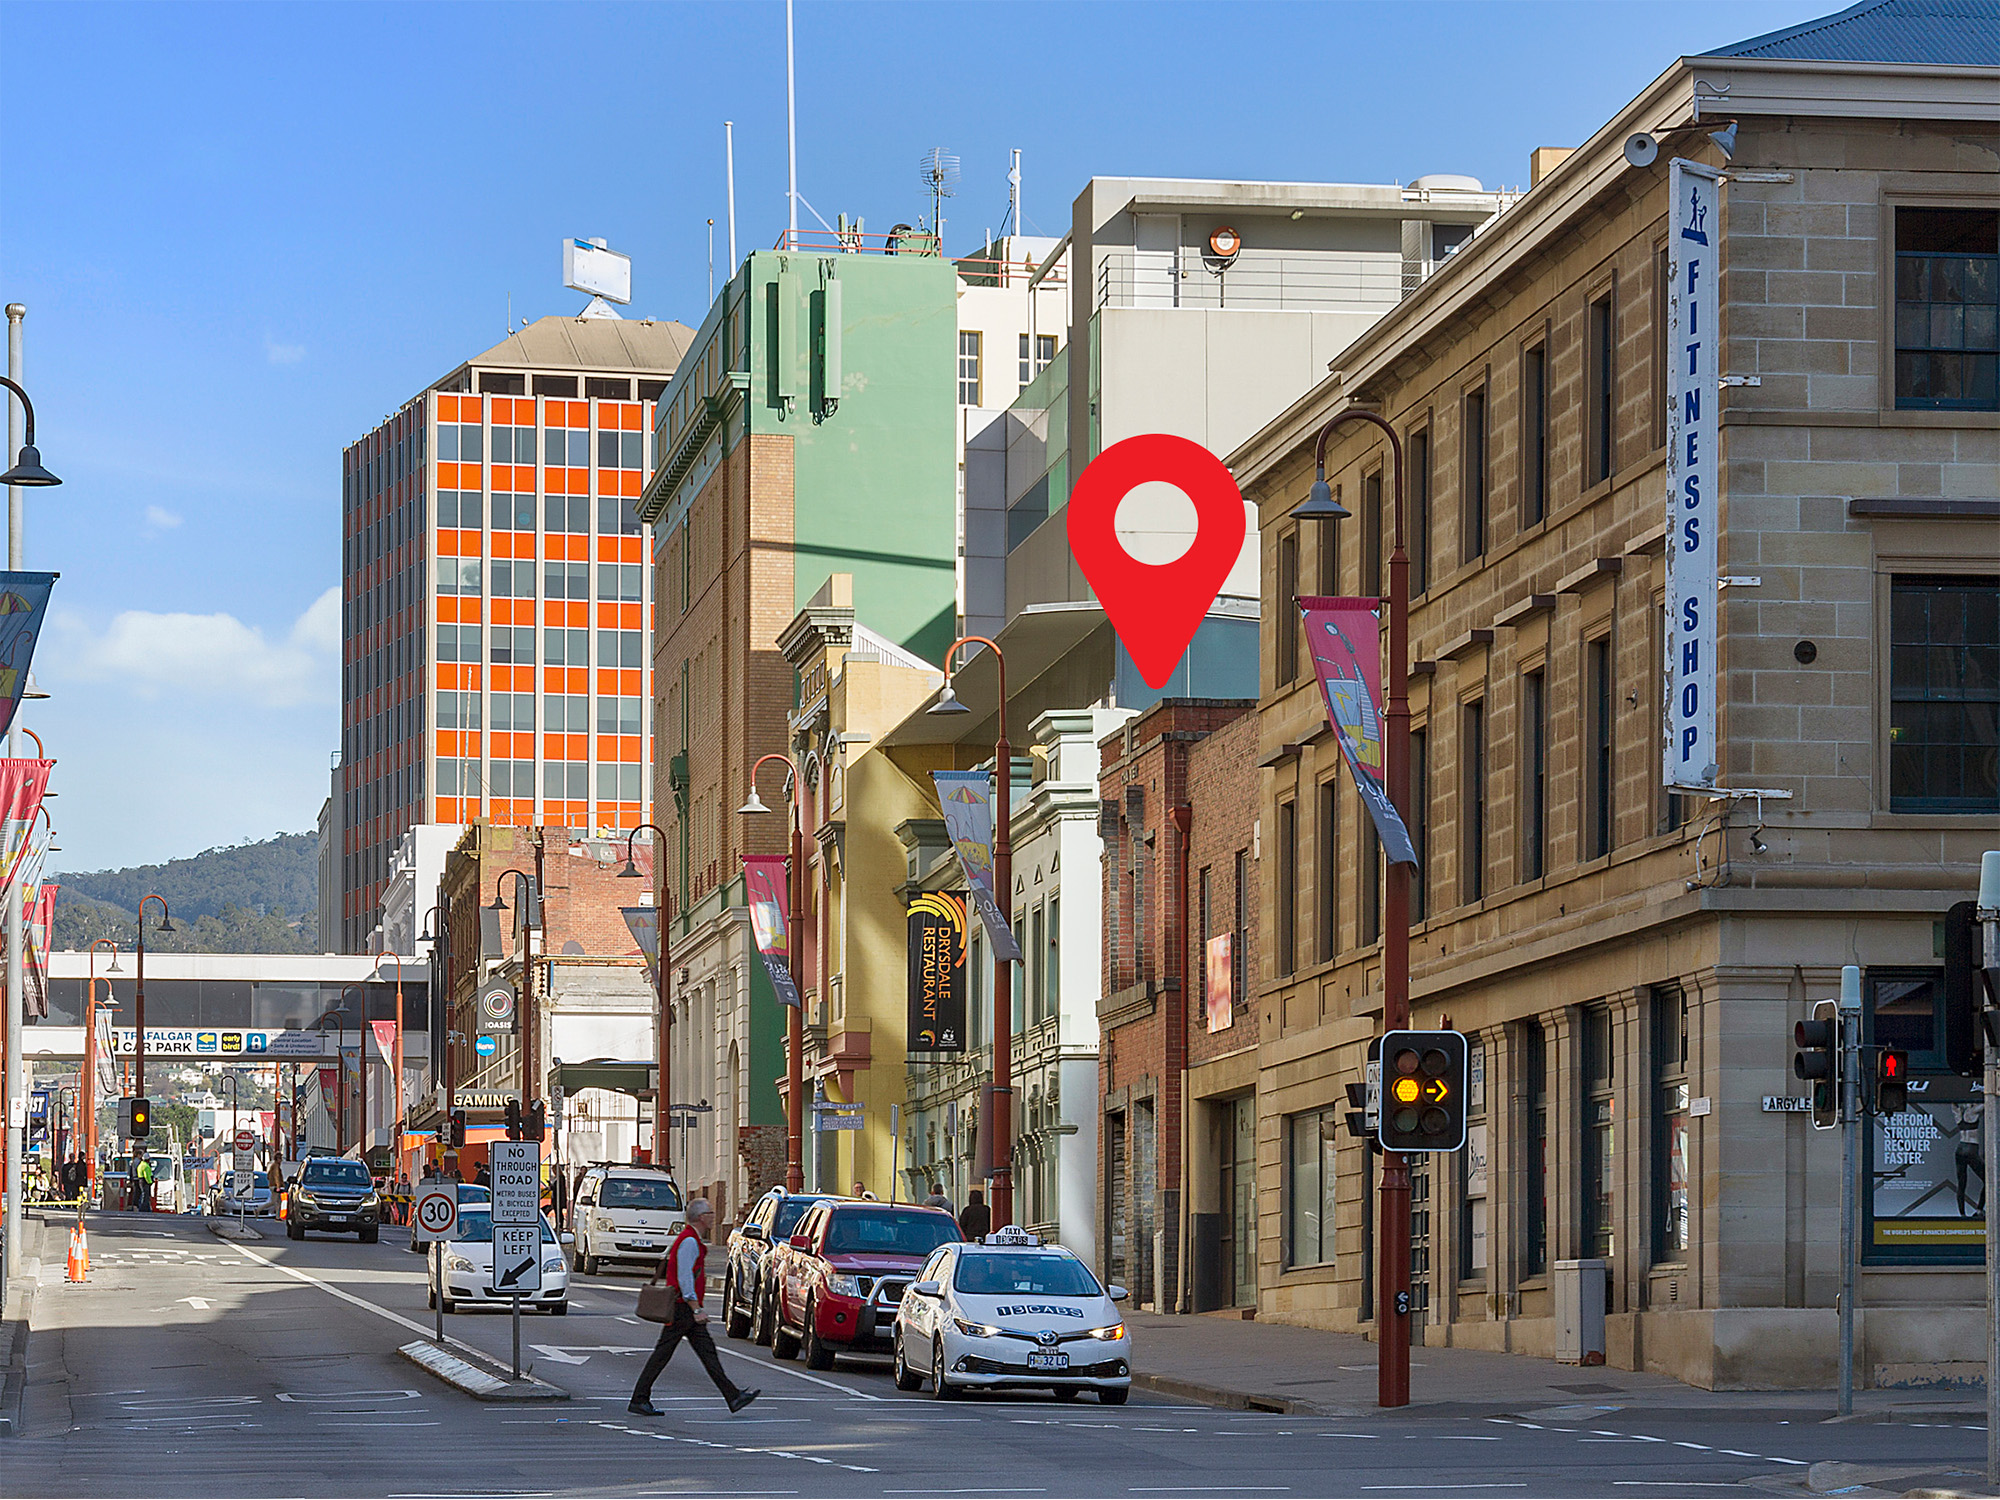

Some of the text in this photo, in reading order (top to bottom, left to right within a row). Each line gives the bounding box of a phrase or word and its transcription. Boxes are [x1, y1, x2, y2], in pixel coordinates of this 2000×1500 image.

[1682, 259, 1700, 763] FITNESS SHOP
[938, 927, 951, 999] DRYSDALE
[923, 927, 936, 1021] RESTAURANT
[487, 1021, 512, 1029] OASIS
[222, 1035, 240, 1043] early
[156, 1042, 192, 1052] PARK
[1768, 1098, 1812, 1110] ARGYLE
[1884, 1127, 1941, 1139] STRONGER.
[1884, 1139, 1931, 1151] RECOVER
[508, 1148, 525, 1158] NO
[1884, 1152, 1925, 1164] FASTER.
[496, 1161, 537, 1172] THROUGH
[499, 1175, 533, 1185] ROAD
[496, 1190, 537, 1198] METRO BUSES
[507, 1200, 534, 1208] BICYCLES
[424, 1201, 450, 1223] 30
[502, 1231, 534, 1242] KEEP
[1005, 1227, 1021, 1235] TAXI
[996, 1236, 1029, 1245] 13CABS
[503, 1244, 533, 1255] LEFT
[998, 1305, 1084, 1318] 13CABS
[1029, 1356, 1067, 1366] H 32 LD
